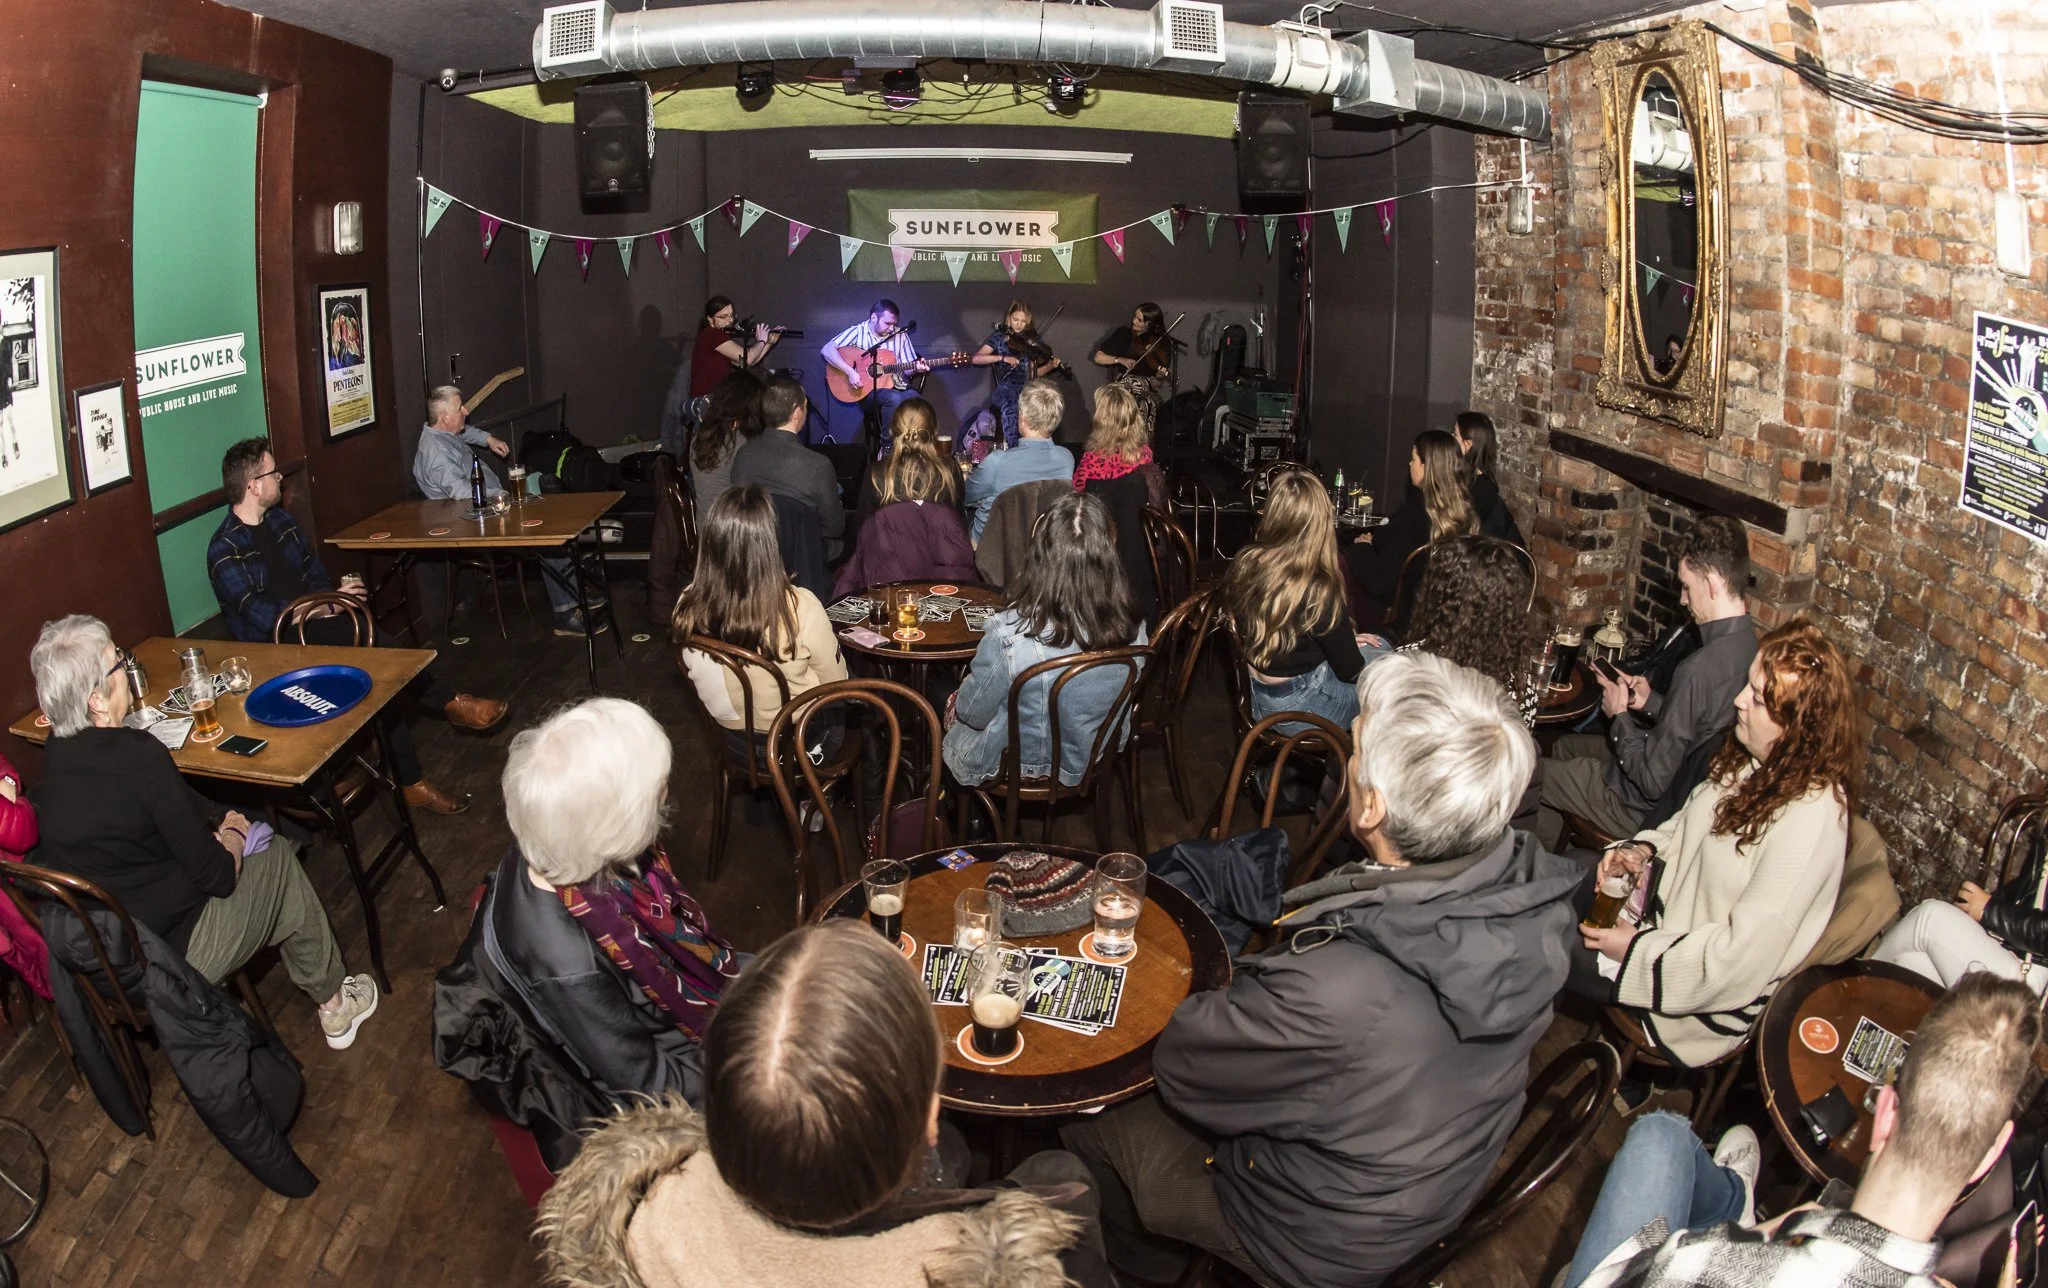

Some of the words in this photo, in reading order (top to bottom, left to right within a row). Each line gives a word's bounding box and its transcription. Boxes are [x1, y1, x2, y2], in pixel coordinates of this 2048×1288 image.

[906, 221, 1041, 237] SUNFLOWER
[911, 252, 937, 261] UBLIC
[971, 253, 988, 262] AND
[1019, 253, 1042, 263] USIC
[136, 348, 234, 384] SUNFLOWER
[333, 374, 364, 392] PENTECOST
[164, 396, 186, 412] HOUSE
[188, 393, 201, 405] AND
[202, 390, 217, 401] LIVE
[218, 384, 237, 397] MUSIC
